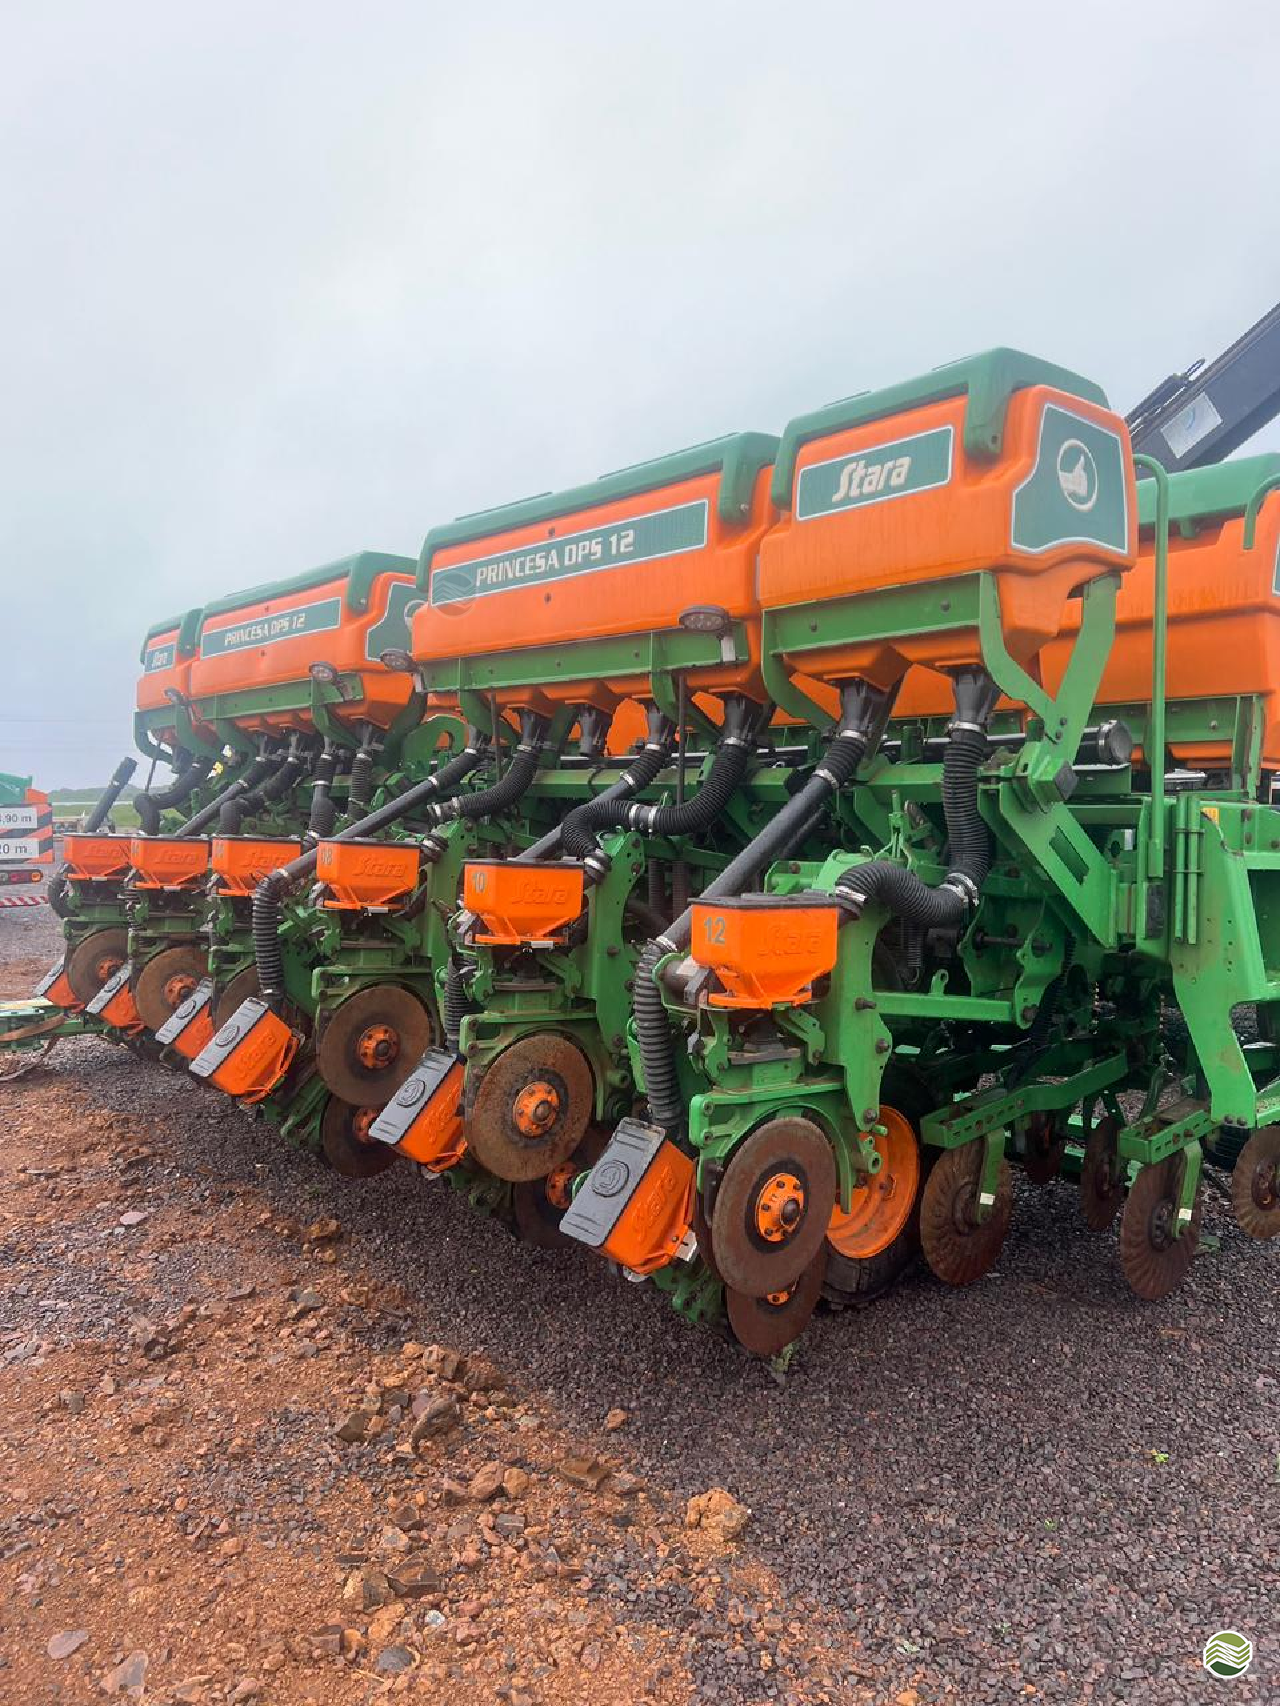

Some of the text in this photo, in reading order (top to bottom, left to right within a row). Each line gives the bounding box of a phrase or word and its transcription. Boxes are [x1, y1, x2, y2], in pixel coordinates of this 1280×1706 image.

[831, 456, 912, 502] Stara
[475, 528, 635, 587] PRINCESA DPS 12
[224, 612, 306, 647] PRINCESA DPS 12
[15, 845, 28, 854] m
[704, 916, 726, 946] 12
